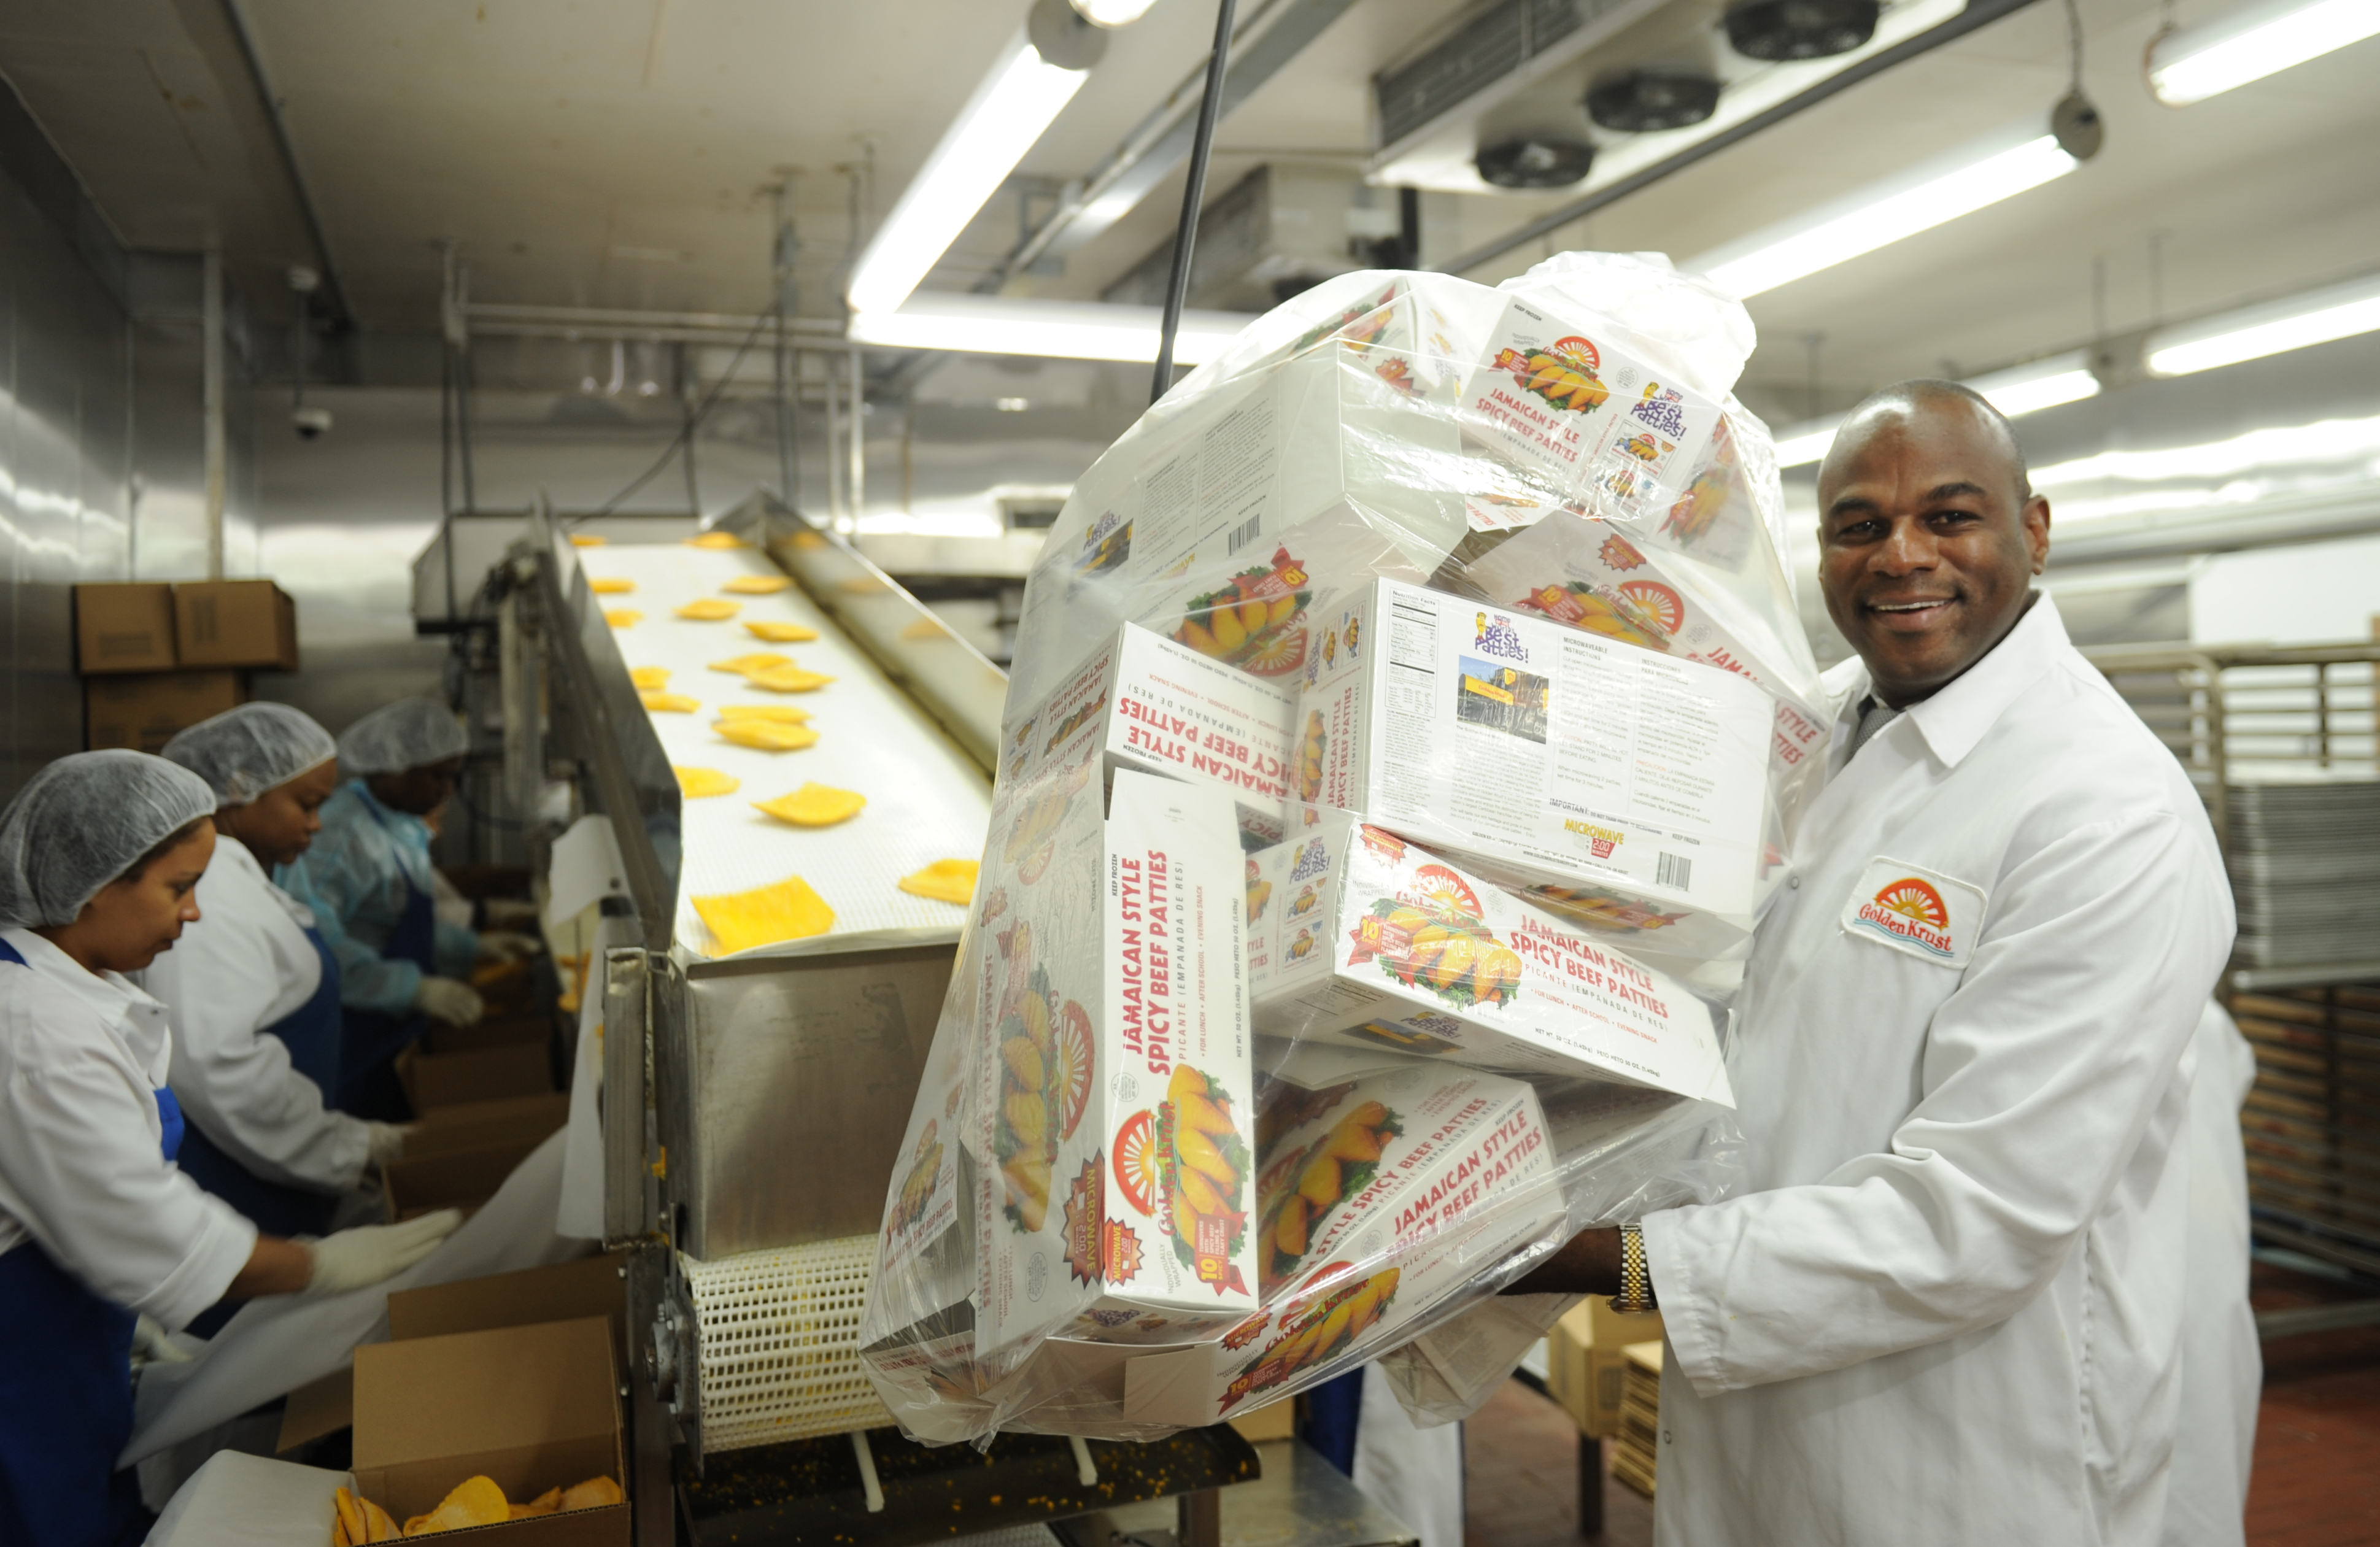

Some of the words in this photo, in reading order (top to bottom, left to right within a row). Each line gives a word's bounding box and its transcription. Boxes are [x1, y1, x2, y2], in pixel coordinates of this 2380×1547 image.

[1525, 309, 1542, 322] FROZEN
[1501, 350, 1512, 361] 10
[1490, 388, 1547, 425] JAMAICAN
[1547, 419, 1580, 444] STYLE
[1630, 403, 1687, 441] Patties!
[1647, 400, 1683, 426] Best
[1476, 398, 1510, 420] SPICY
[1510, 419, 1535, 438] BEEF
[1535, 432, 1578, 463] PATTIES
[1501, 431, 1540, 457] (EMPANADA
[1542, 455, 1551, 465] DE
[1238, 505, 1250, 516] KEEP
[1249, 494, 1266, 510] FROZEN
[1285, 568, 1307, 585] 10
[1393, 590, 1419, 601] Nutrition
[1420, 597, 1436, 606] Facts
[1547, 586, 1563, 603] 10
[1494, 614, 1511, 623] Home
[1475, 638, 1528, 664] Patties!
[1485, 625, 1520, 649] Best
[1564, 636, 1608, 654] MICROWAVEABLE
[1088, 654, 1110, 679] SPICY
[1563, 646, 1601, 661] INSTRUCTIONS
[1642, 658, 1681, 673] INSTRUCCIONES
[1073, 674, 1089, 690] BEEF
[1149, 673, 1170, 687] SNACK
[1641, 667, 1655, 676] PARA
[1048, 688, 1073, 714] PATTIES
[1067, 674, 1103, 711] JAMAICAN
[1128, 683, 1154, 700] RES)
[1160, 696, 1173, 708] DE
[1171, 681, 1198, 698] EVENING
[1049, 702, 1068, 726] STYLE
[1119, 697, 1199, 743] PATTIES
[1207, 697, 1230, 714] SCHOOL
[1332, 698, 1341, 737] STYLE
[1342, 686, 1352, 736] PATTIES
[1180, 704, 1246, 738] (EMPANADA
[1777, 707, 1818, 744] STYLE
[1123, 744, 1146, 757] FROZEN
[1128, 725, 1186, 763] STYLE
[1203, 732, 1250, 764] BEEF
[1340, 739, 1349, 768] BEEF
[1327, 738, 1339, 805] JAMAICAN
[1337, 772, 1346, 809] SPICY
[1549, 798, 1590, 816] IMPORTANT:
[1364, 830, 1402, 853] MICROWAVE
[1564, 818, 1625, 845] MICROWAVE
[1593, 839, 1610, 852] 2:00
[1672, 833, 1683, 842] KEEP
[1683, 836, 1701, 846] FROZEN
[1591, 849, 1609, 858] MINUTES
[1175, 862, 1184, 890] RES)
[1289, 855, 1331, 884] Patties!
[1122, 858, 1142, 922] STYLE
[1148, 850, 1168, 938] PATTIES
[1175, 896, 1184, 911] DE
[1396, 890, 1450, 926] Golden
[1361, 918, 1379, 939] 10
[1361, 936, 1378, 946] SPICY
[1858, 903, 1906, 934] Golden
[1907, 919, 1952, 952] Krust
[1176, 918, 1186, 995] (EMPANADA
[1521, 914, 1606, 969] JAMAICAN
[1609, 957, 1655, 993] STYLE
[1149, 942, 1169, 997] BEEF
[1510, 932, 1561, 970] SPICY
[1566, 957, 1603, 987] BEEF
[1607, 976, 1669, 1019] PATTIES
[1122, 928, 1143, 1055] JAMAICAN
[1525, 963, 1567, 988] PICANTE
[1572, 983, 1628, 1014] (EMPANADA
[1632, 1010, 1643, 1020] DE
[1178, 1002, 1186, 1060] PICANTE
[1534, 989, 1545, 998] FOR
[1546, 992, 1564, 1005] LUNCH
[1572, 1003, 1588, 1016] AFTER
[1589, 1010, 1610, 1024] SCHOOL
[1617, 1022, 1639, 1036] EVENING
[1640, 1032, 1658, 1043] SNACK
[1148, 999, 1171, 1076] SPICY
[1507, 1098, 1525, 1117] FROZEN
[1157, 1101, 1176, 1159] Krust
[1316, 1211, 1357, 1256] STYLE
[1352, 1170, 1400, 1210] SPICY
[1397, 1141, 1434, 1170] BEEF
[1430, 1097, 1488, 1142] PATTIES
[1394, 1149, 1482, 1236] JAMAICAN
[1483, 1109, 1528, 1160] STYLE
[1442, 1179, 1480, 1223] BEEF
[1483, 1126, 1542, 1190] PATTIES
[1509, 1173, 1521, 1187] DE
[1524, 1152, 1544, 1175] RES)
[1157, 1162, 1176, 1236] Golden
[1380, 1171, 1416, 1203] PICANTE
[1086, 1168, 1095, 1271] MICROWAVE
[1113, 1225, 1122, 1280] MICROWAVE
[1159, 1244, 1173, 1294] INDIVIDUALLY
[1168, 1250, 1181, 1288] WRAPPED
[1200, 1258, 1218, 1281] 10
[1265, 1308, 1324, 1352] Golden
[1324, 1278, 1370, 1311] Krust
[1230, 1378, 1250, 1393] 10
